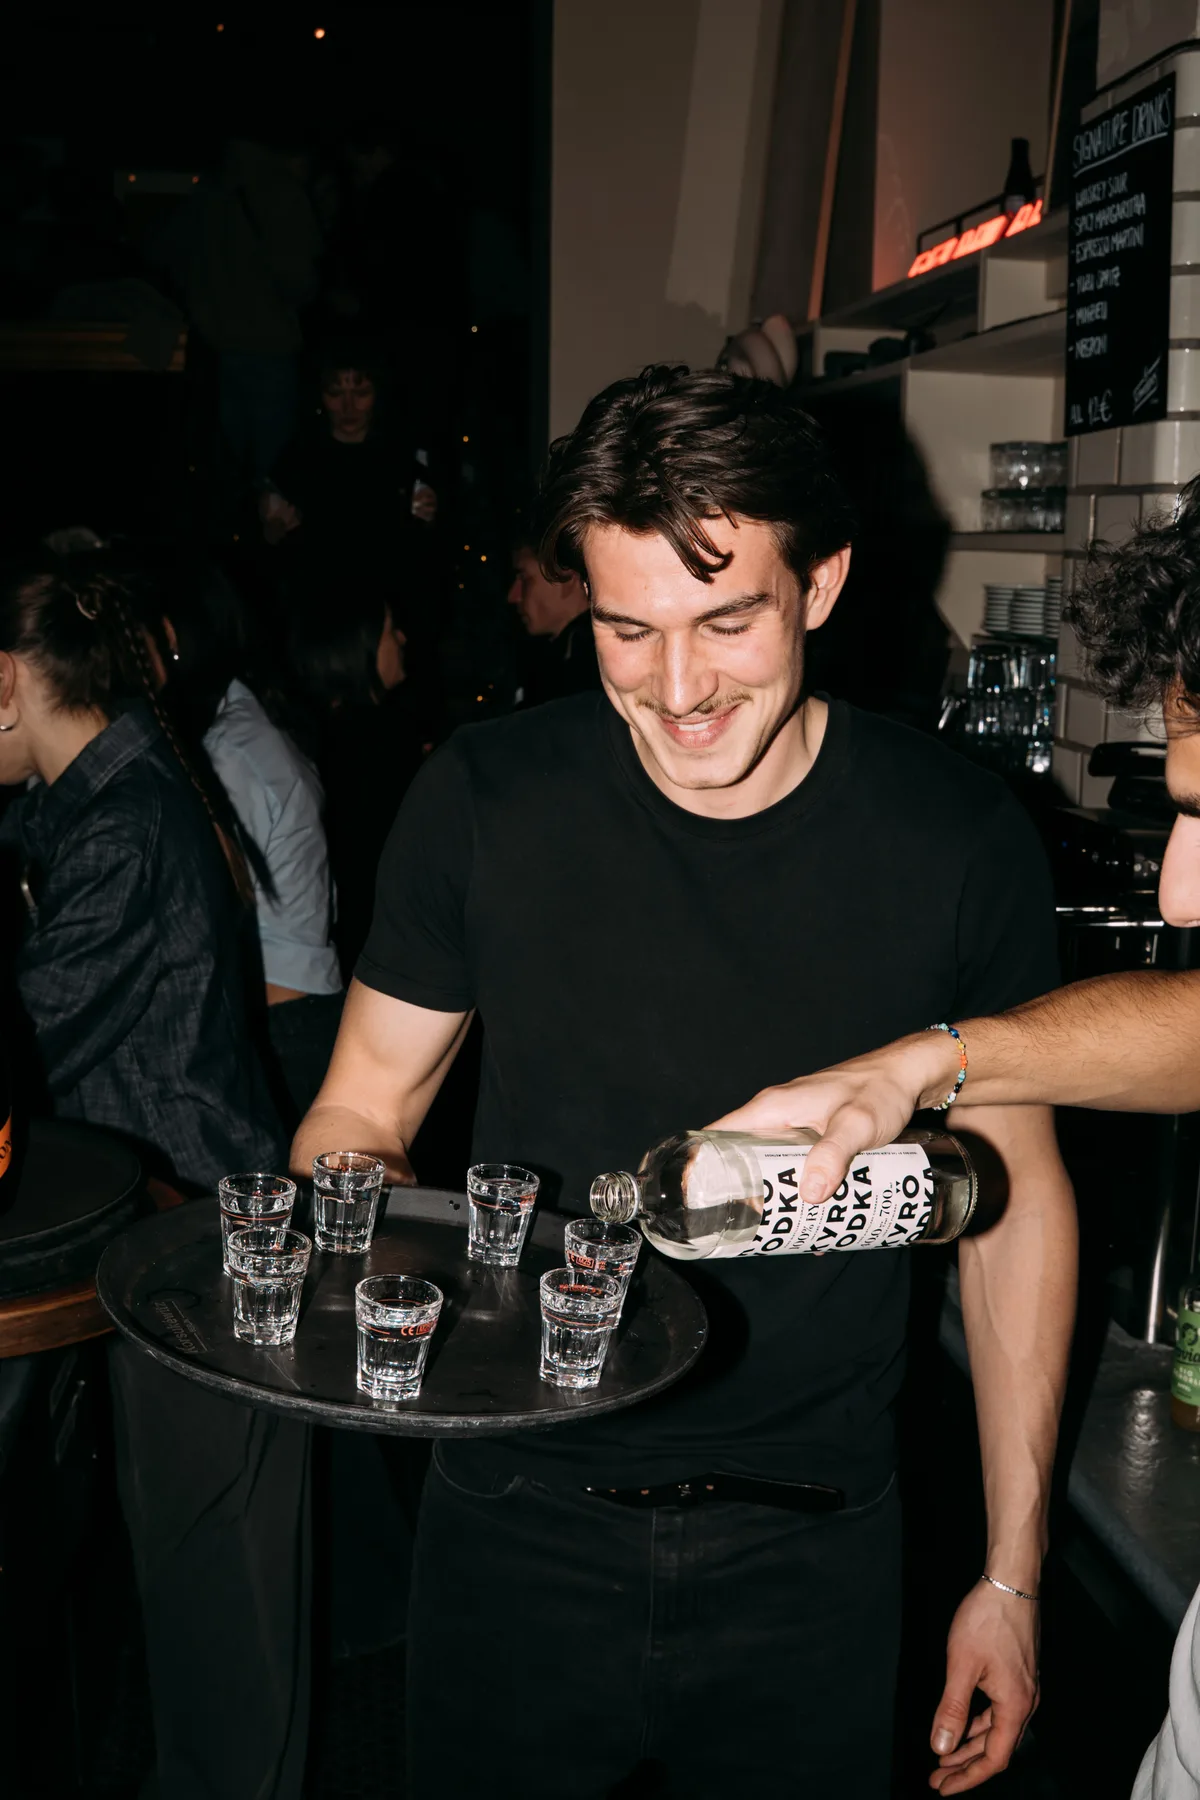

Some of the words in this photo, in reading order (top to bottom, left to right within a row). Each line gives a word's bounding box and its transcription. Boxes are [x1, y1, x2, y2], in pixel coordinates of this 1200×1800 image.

[1073, 109, 1129, 169] SIGNATURE
[1131, 87, 1172, 145] DRINKS
[1107, 171, 1128, 199] SOUR
[1111, 223, 1145, 252] MARTINI
[754, 1167, 799, 1256] ODKA
[829, 1165, 873, 1252] ODKA
[875, 1174, 920, 1249] KYRÖ
[879, 1189, 893, 1217] 700
[400, 1325, 414, 1336] CE
